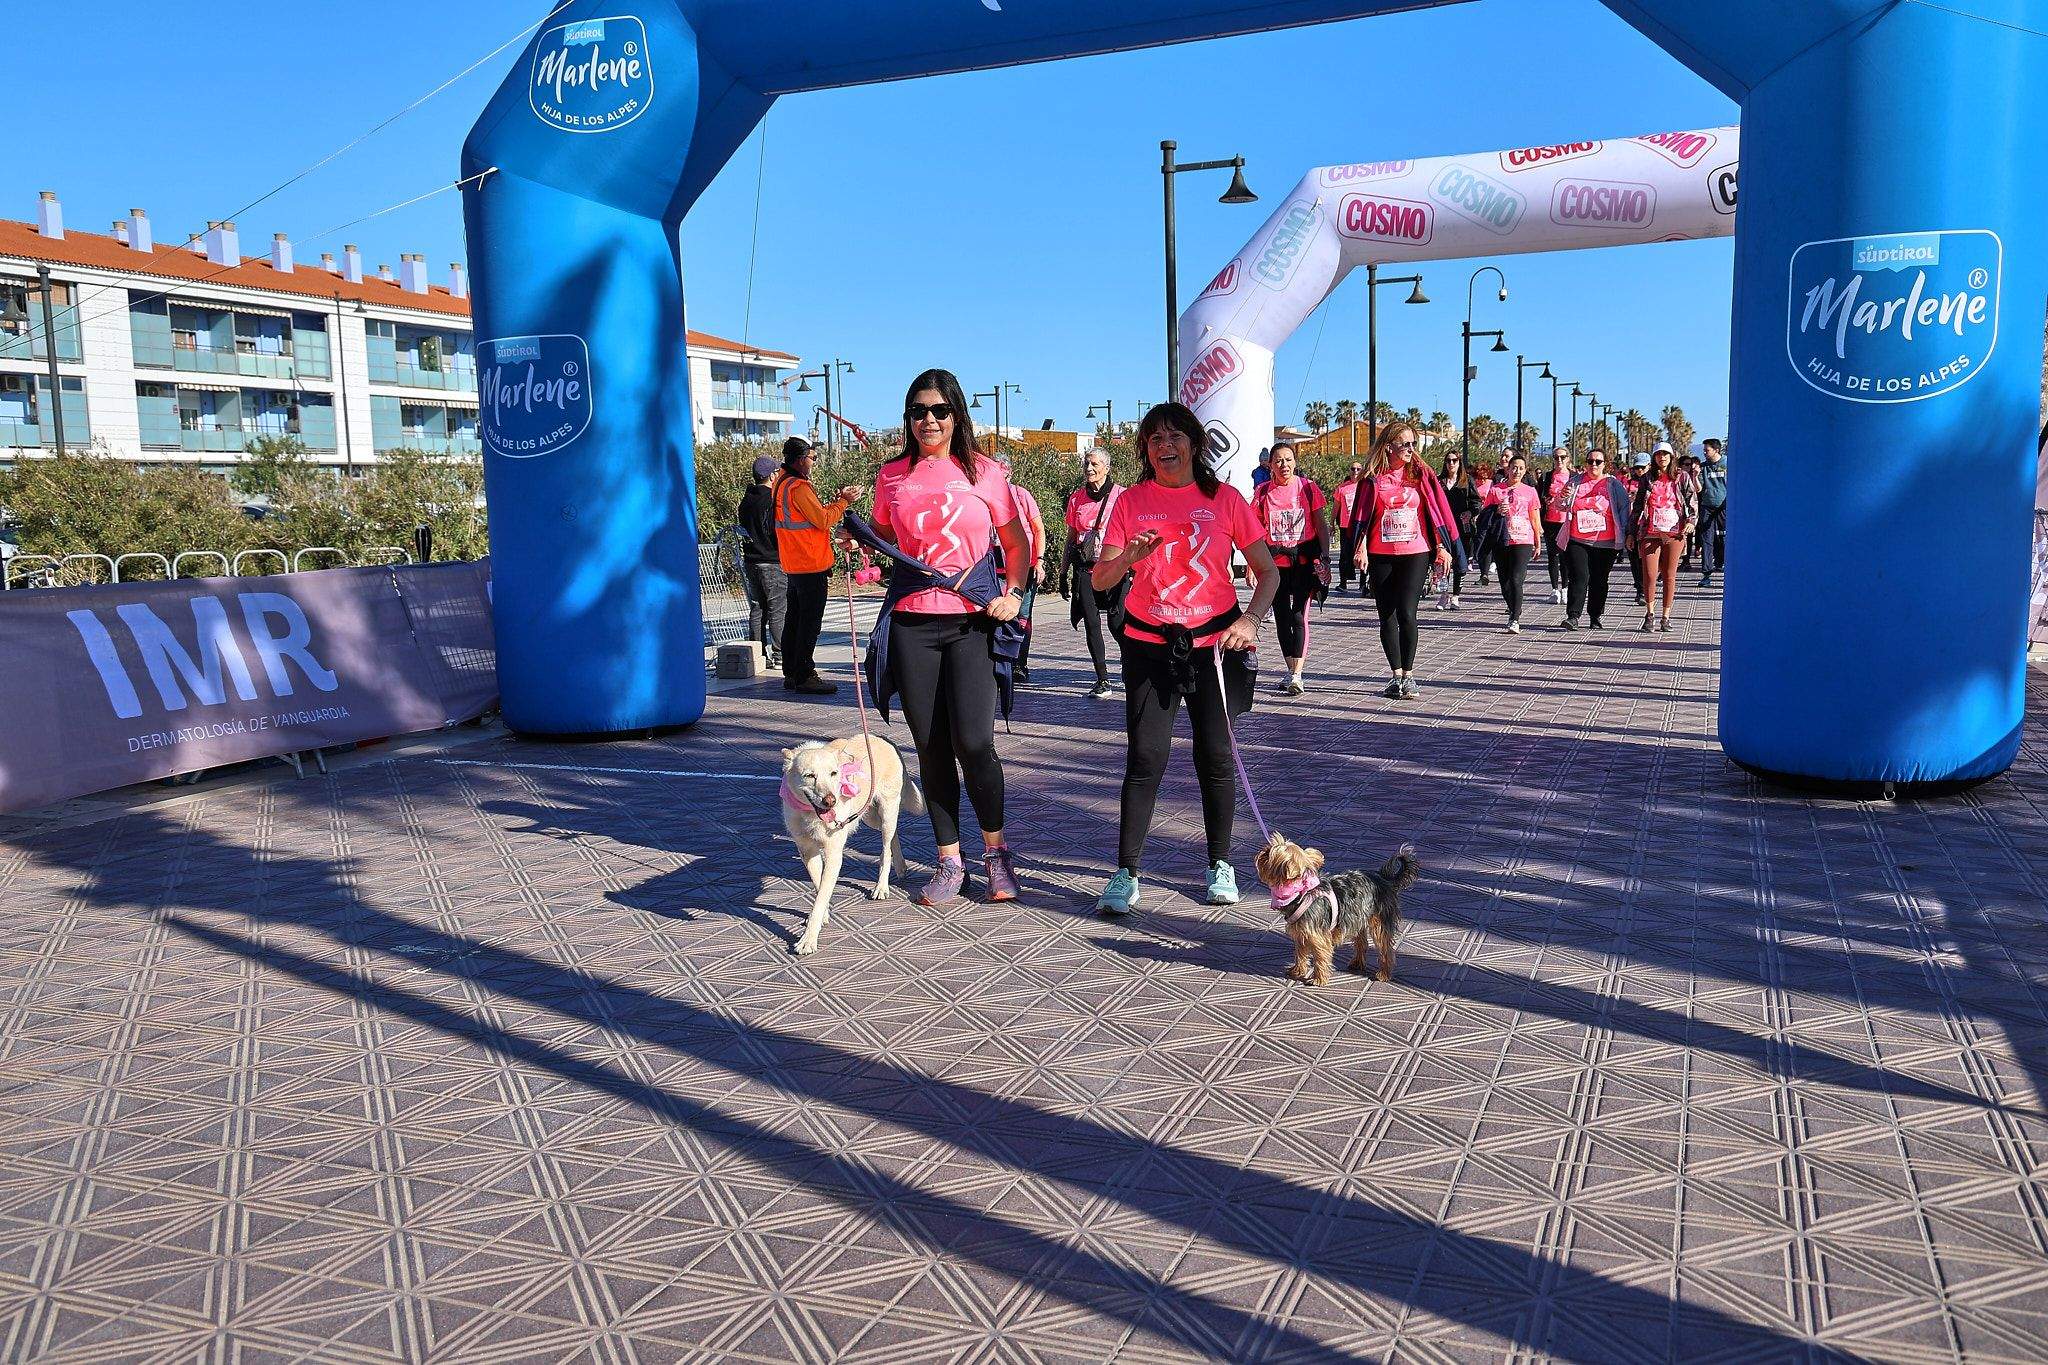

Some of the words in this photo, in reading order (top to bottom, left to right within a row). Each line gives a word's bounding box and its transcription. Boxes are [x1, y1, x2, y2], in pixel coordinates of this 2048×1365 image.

[541, 102, 562, 121] HIJA
[565, 115, 580, 125] DE
[582, 115, 604, 125] LOS
[607, 99, 638, 122] ALPES
[1438, 169, 1518, 227] COSMO
[1560, 184, 1647, 223] COSMO
[1346, 199, 1426, 240] COSMO
[1257, 207, 1316, 281] COSMO
[1807, 357, 1841, 386] HIJA
[1846, 375, 1870, 391] DE
[1876, 377, 1912, 392] LOS
[1918, 354, 1970, 388] ALPES
[487, 425, 501, 445] HIJA
[502, 439, 514, 449] DE
[516, 439, 536, 450] LOS
[539, 422, 573, 446] ALPES
[1138, 513, 1167, 521] OYSHO
[1174, 608, 1182, 616] DE
[1184, 607, 1193, 616] LA
[66, 592, 339, 719] IMR
[128, 718, 247, 752] DERMATOLOGÍA
[250, 716, 268, 732] DE
[273, 706, 351, 728] VANGUARDIA
